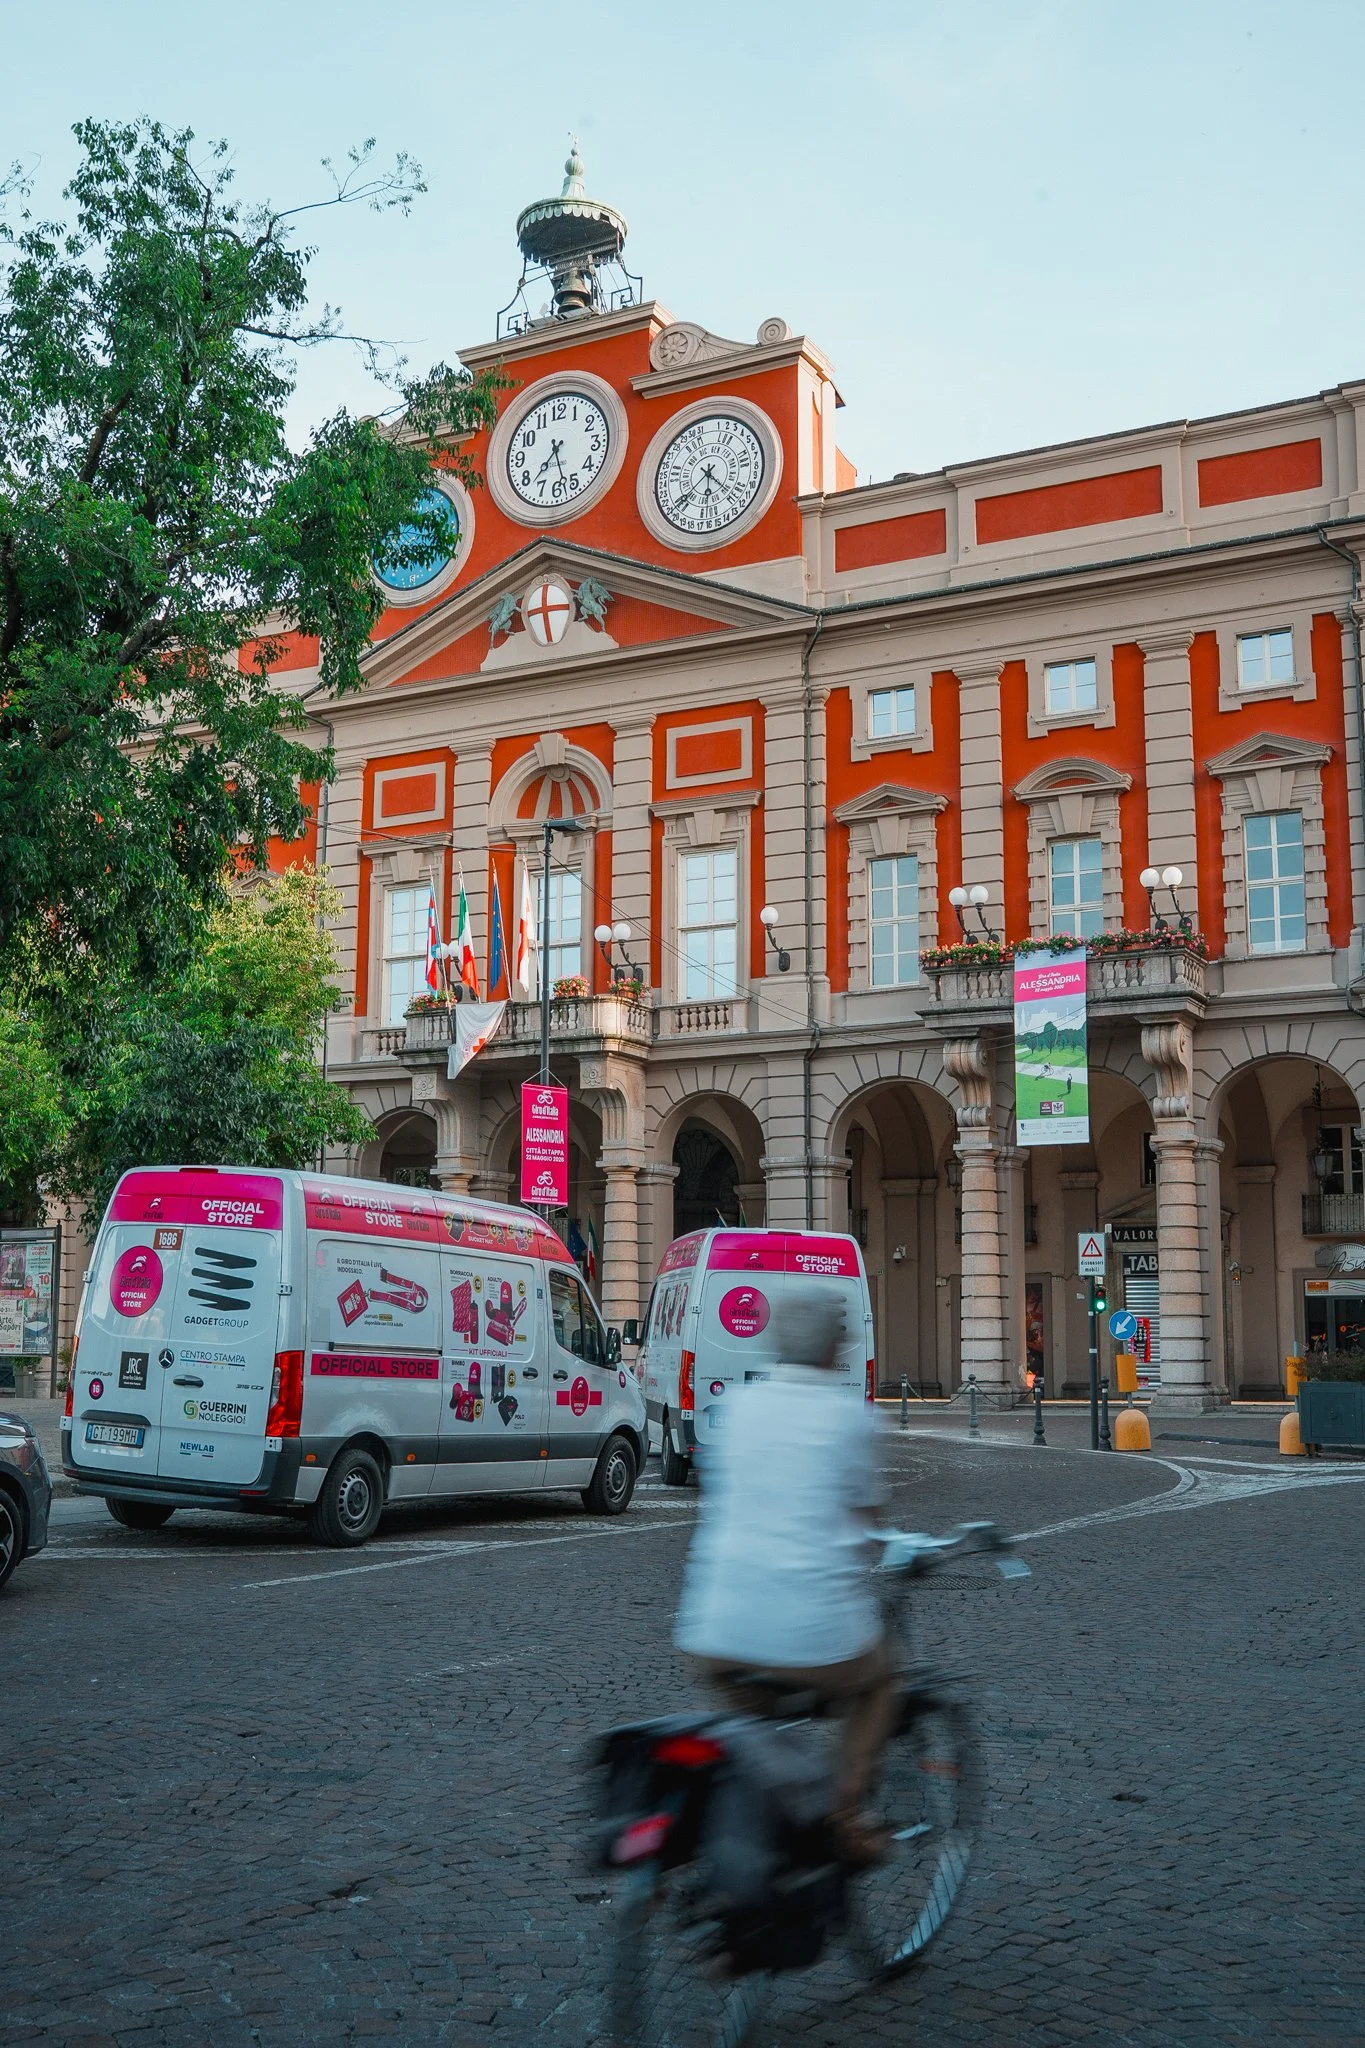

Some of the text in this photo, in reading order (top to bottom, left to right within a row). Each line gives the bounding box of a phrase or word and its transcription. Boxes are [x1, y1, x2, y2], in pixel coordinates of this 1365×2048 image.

[551, 403, 566, 421] 12
[572, 405, 577, 421] 1
[536, 412, 547, 430] 11
[584, 414, 595, 432] 2
[725, 422, 730, 430] 2
[697, 426, 704, 434] 31
[732, 423, 738, 431] 3
[522, 430, 536, 448] 10
[590, 434, 600, 451] 3
[746, 435, 751, 443] 5
[751, 442, 755, 450] 6
[515, 451, 525, 468] 9
[754, 452, 758, 460] 7
[582, 455, 594, 472] 4
[662, 461, 670, 470] 26
[754, 461, 758, 470] 8
[522, 470, 530, 486] 8
[660, 471, 668, 480] 25
[754, 471, 758, 479] 9
[570, 473, 579, 490] 5
[750, 480, 756, 489] 10
[536, 480, 547, 497] 7
[552, 481, 563, 498] 6
[660, 490, 668, 498] 23
[726, 482, 746, 504] MERC
[746, 491, 750, 499] 11
[662, 499, 669, 507] 22
[739, 499, 746, 508] 12
[672, 513, 679, 521] 20
[732, 507, 738, 516] 13
[680, 518, 686, 526] 19
[715, 518, 722, 527] 15
[723, 513, 730, 522] 14
[688, 520, 694, 529] 18
[697, 522, 704, 530] 17
[706, 520, 712, 528] 16
[1020, 974, 1080, 990] ALESSANDRIA
[532, 1104, 543, 1114] Giro
[526, 1128, 564, 1144] ALESSANDRIA
[532, 1186, 542, 1196] Giro
[201, 1200, 265, 1214] OFFICIAL
[342, 1194, 395, 1212] OFFICIAL
[207, 1212, 253, 1225] STORE
[365, 1212, 403, 1228] STORE
[159, 1232, 178, 1246] 1686
[795, 1255, 845, 1266] OFFICIAL
[1129, 1256, 1158, 1271] TAB
[802, 1264, 839, 1274] STORE
[184, 1316, 249, 1328] GADGETGROUP
[180, 1350, 245, 1363] CENTRO STAMPA
[126, 1357, 142, 1374] JRC
[320, 1358, 384, 1374] OFFICIAL
[391, 1361, 432, 1376] STORE
[92, 1384, 100, 1392] 16
[200, 1400, 246, 1414] GUERRINI
[199, 1412, 243, 1423] NOLEGGIO
[93, 1426, 137, 1443] GT 199MH
[180, 1442, 214, 1452] NEWLAB
